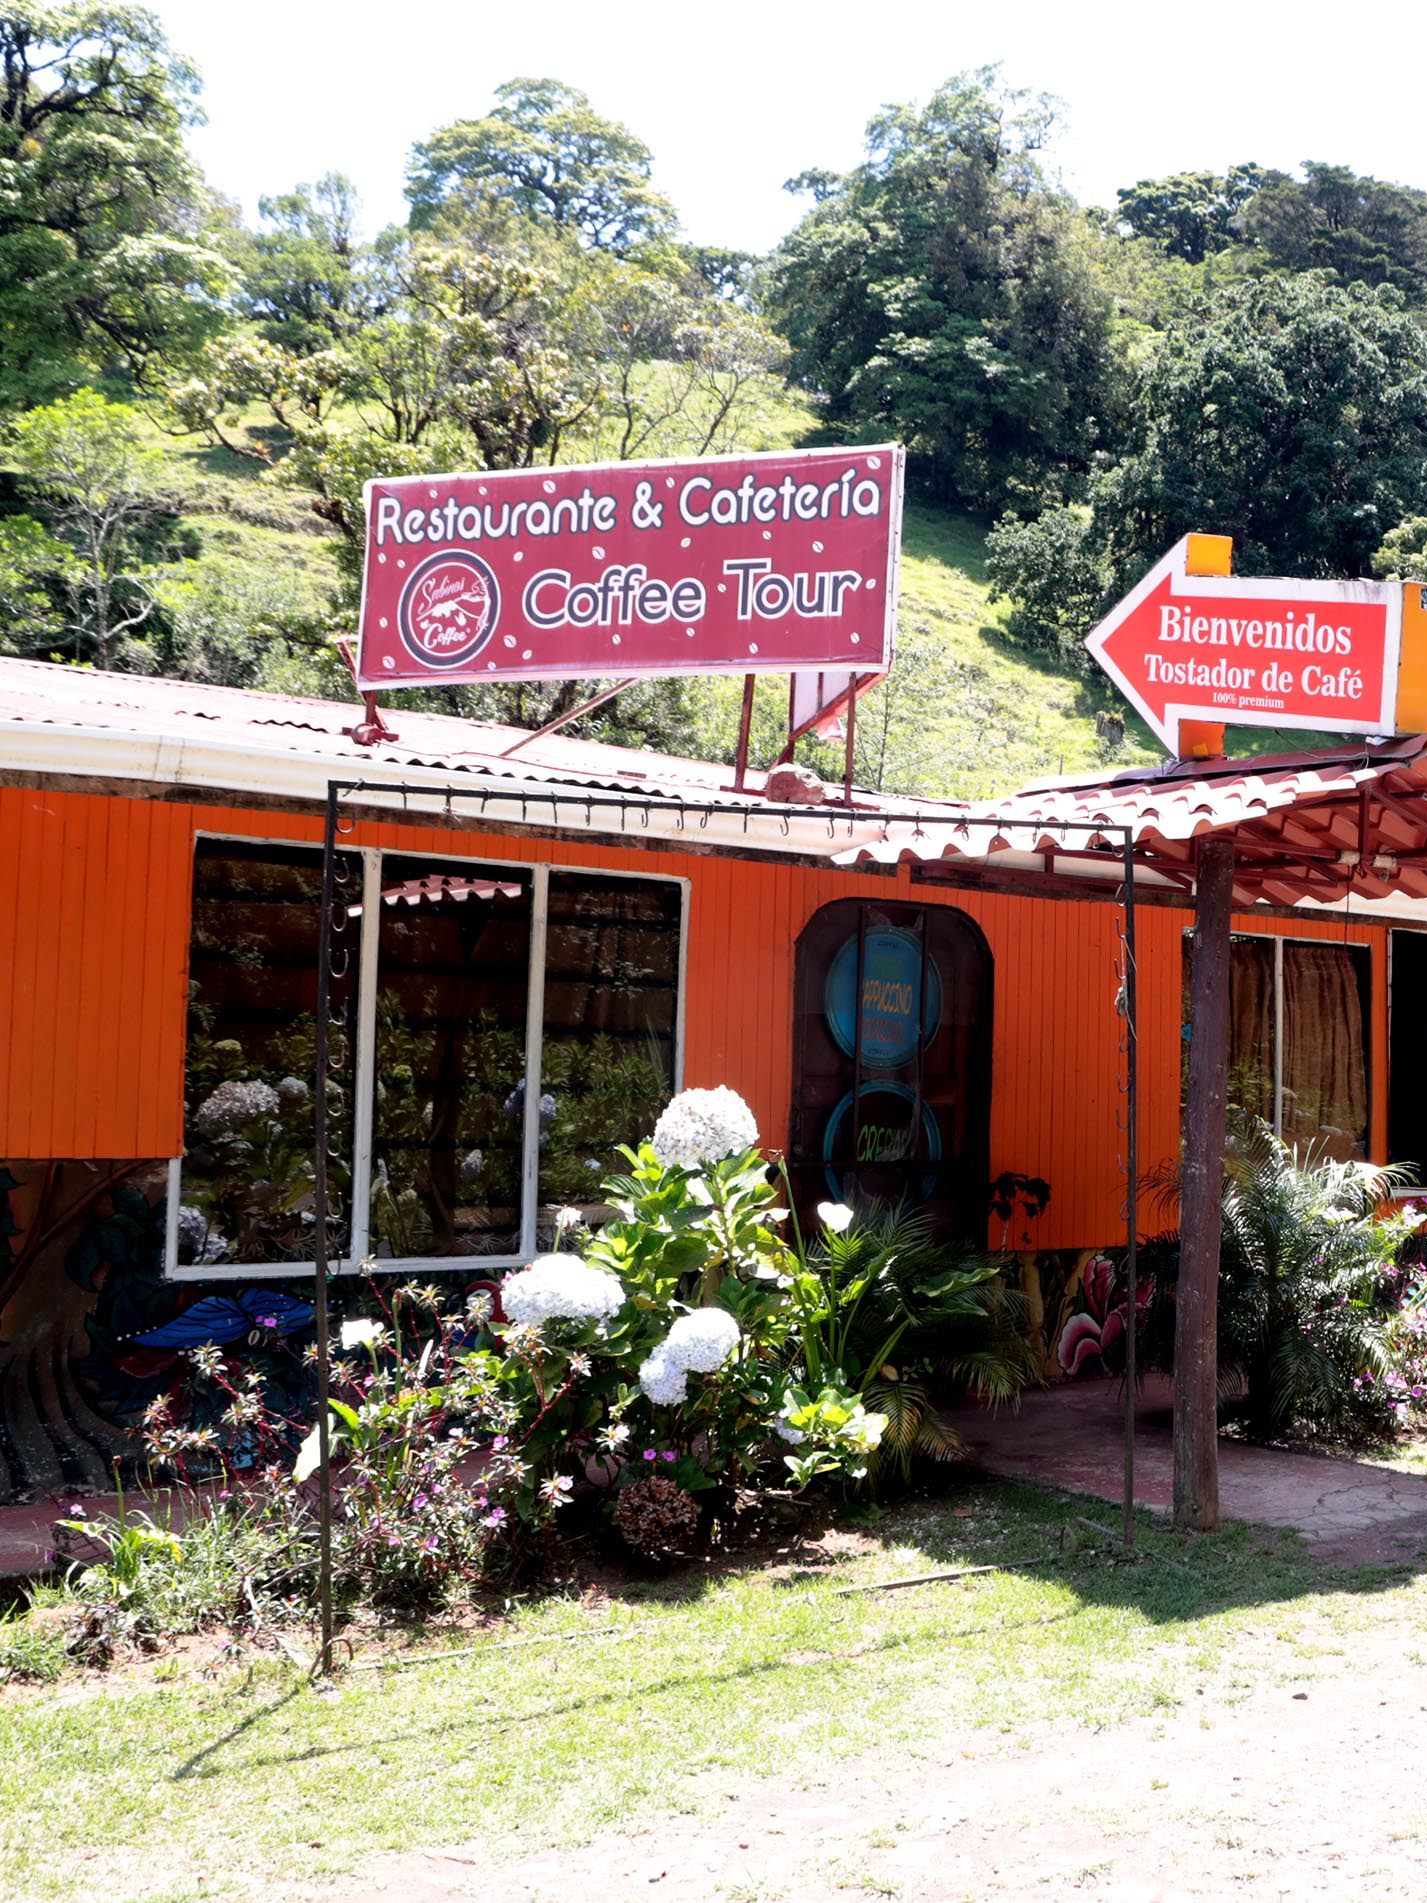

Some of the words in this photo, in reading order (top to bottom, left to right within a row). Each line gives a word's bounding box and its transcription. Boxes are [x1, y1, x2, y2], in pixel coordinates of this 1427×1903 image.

[375, 487, 618, 546] Restaurante
[631, 480, 664, 529] &
[678, 467, 881, 527] Cafetería
[522, 564, 706, 629] Coffee
[723, 557, 861, 621] Tour
[1158, 605, 1352, 655] Bienvenidos
[1144, 654, 1255, 690] Tostador
[1261, 661, 1293, 693] de
[1301, 664, 1363, 699] Café
[1212, 692, 1237, 705] 100%
[1238, 694, 1285, 709] premium
